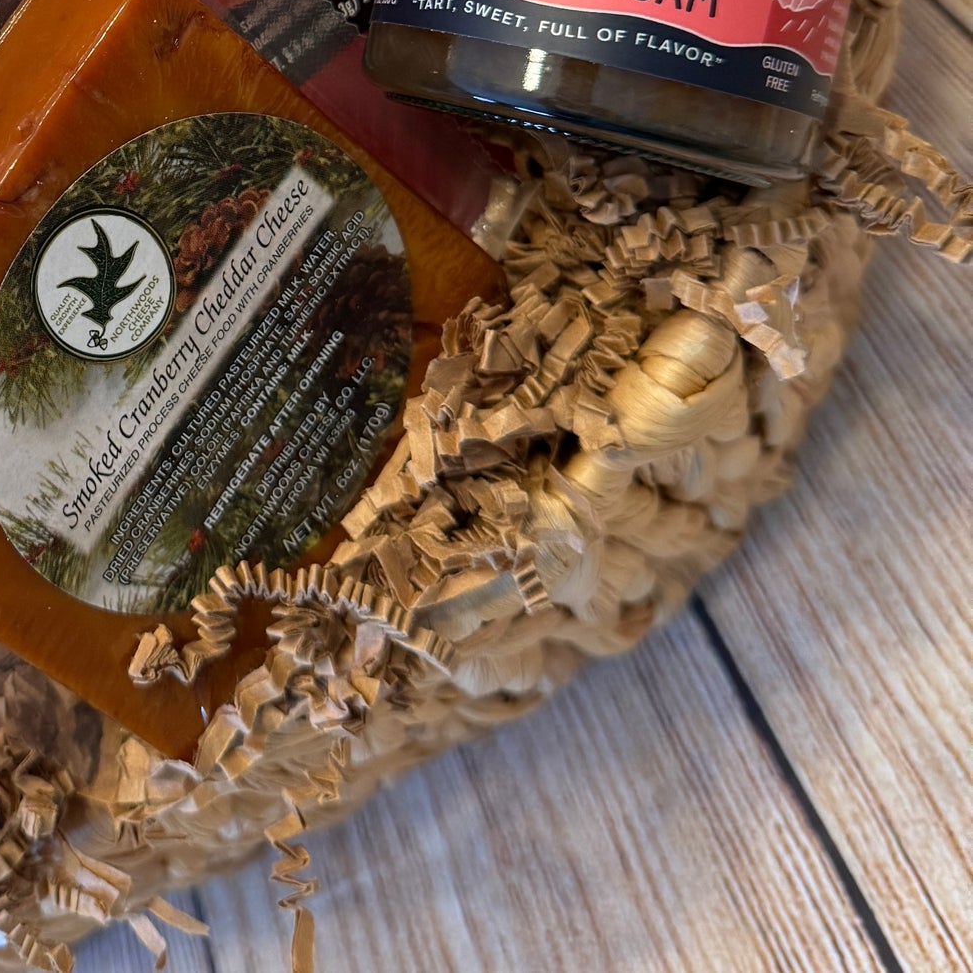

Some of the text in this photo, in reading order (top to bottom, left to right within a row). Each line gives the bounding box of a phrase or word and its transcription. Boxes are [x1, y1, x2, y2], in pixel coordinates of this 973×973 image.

[464, 0, 528, 32] SWEET,
[538, 20, 587, 39] FULL
[596, 27, 627, 42] OF
[762, 55, 800, 77] GLUTEN
[766, 74, 791, 93] FREE
[51, 293, 70, 320] QUALITY
[56, 297, 76, 326] GROWTH
[59, 297, 85, 335] EXPERIENCE
[111, 275, 158, 342] NORTHWOODS
[129, 296, 153, 331] CHEESE
[131, 296, 163, 341] COMPANY
[62, 179, 309, 529] Smoked Cranberry Cheddar Cheese
[82, 204, 313, 530] PASTEURIZED PROCESS CHEESE FOOD WITH CRANBERRIES
[103, 539, 134, 581] DRIED
[194, 396, 231, 447] SODIUM
[309, 240, 343, 286] SORBIC
[340, 209, 364, 241] ACID
[190, 432, 222, 476] COLOR
[221, 375, 263, 432] (PAPRIKA
[260, 348, 282, 376] AND
[281, 285, 326, 347] TURMERIC
[240, 360, 289, 428] CONTAINS:
[287, 326, 312, 361] MILK.
[110, 456, 174, 545] INGREDIENTS:
[172, 389, 220, 456] CULTURED
[219, 306, 280, 390] PASTEURIZED
[202, 329, 343, 529] REFRIGERATE AFTER OPENING
[232, 459, 303, 556] NORTHWOODS
[299, 407, 337, 460] CHEESE
[334, 382, 354, 408] CO.
[255, 391, 330, 496] DISTRIBUTED BY
[276, 463, 318, 518] VERONA
[314, 445, 329, 464] WI
[282, 517, 312, 552] NET
[356, 402, 393, 453] (170g)
